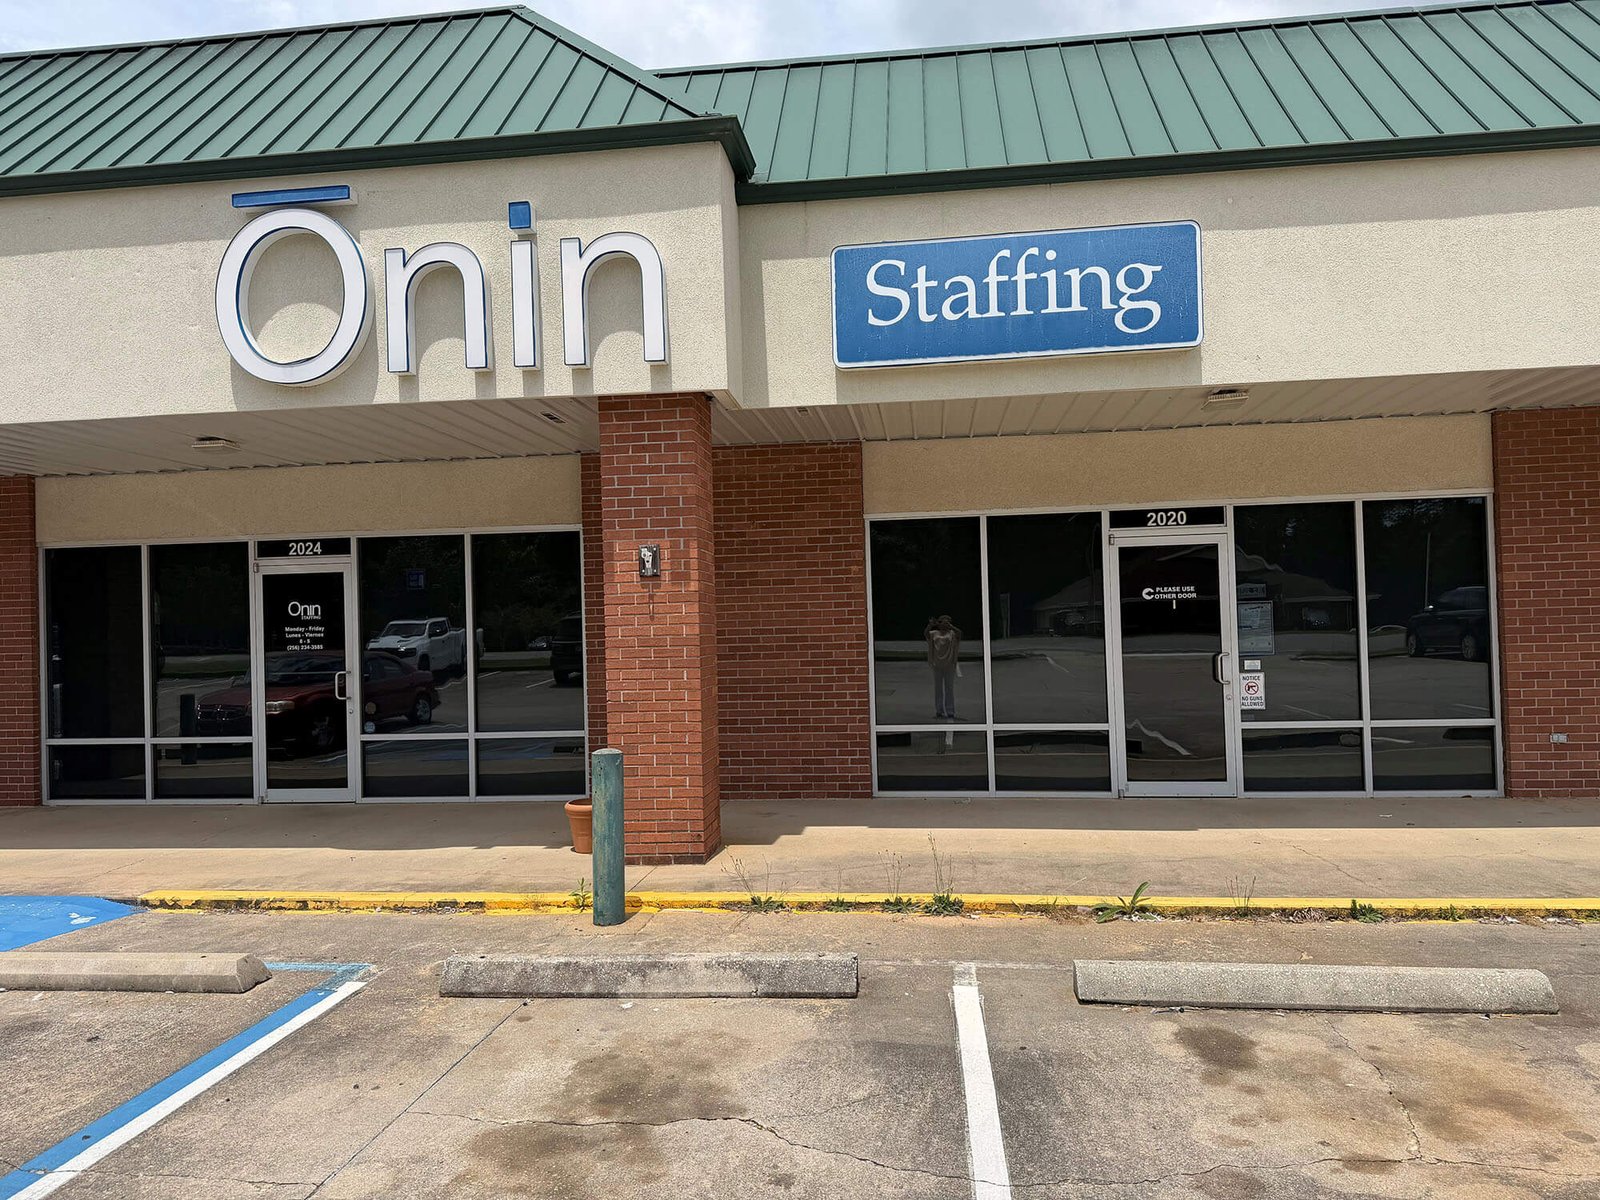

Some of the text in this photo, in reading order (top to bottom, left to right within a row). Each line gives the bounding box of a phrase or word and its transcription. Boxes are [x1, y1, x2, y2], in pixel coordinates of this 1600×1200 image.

[866, 247, 1163, 334] Staffing
[1147, 511, 1187, 526] 2020
[288, 542, 322, 555] 2024
